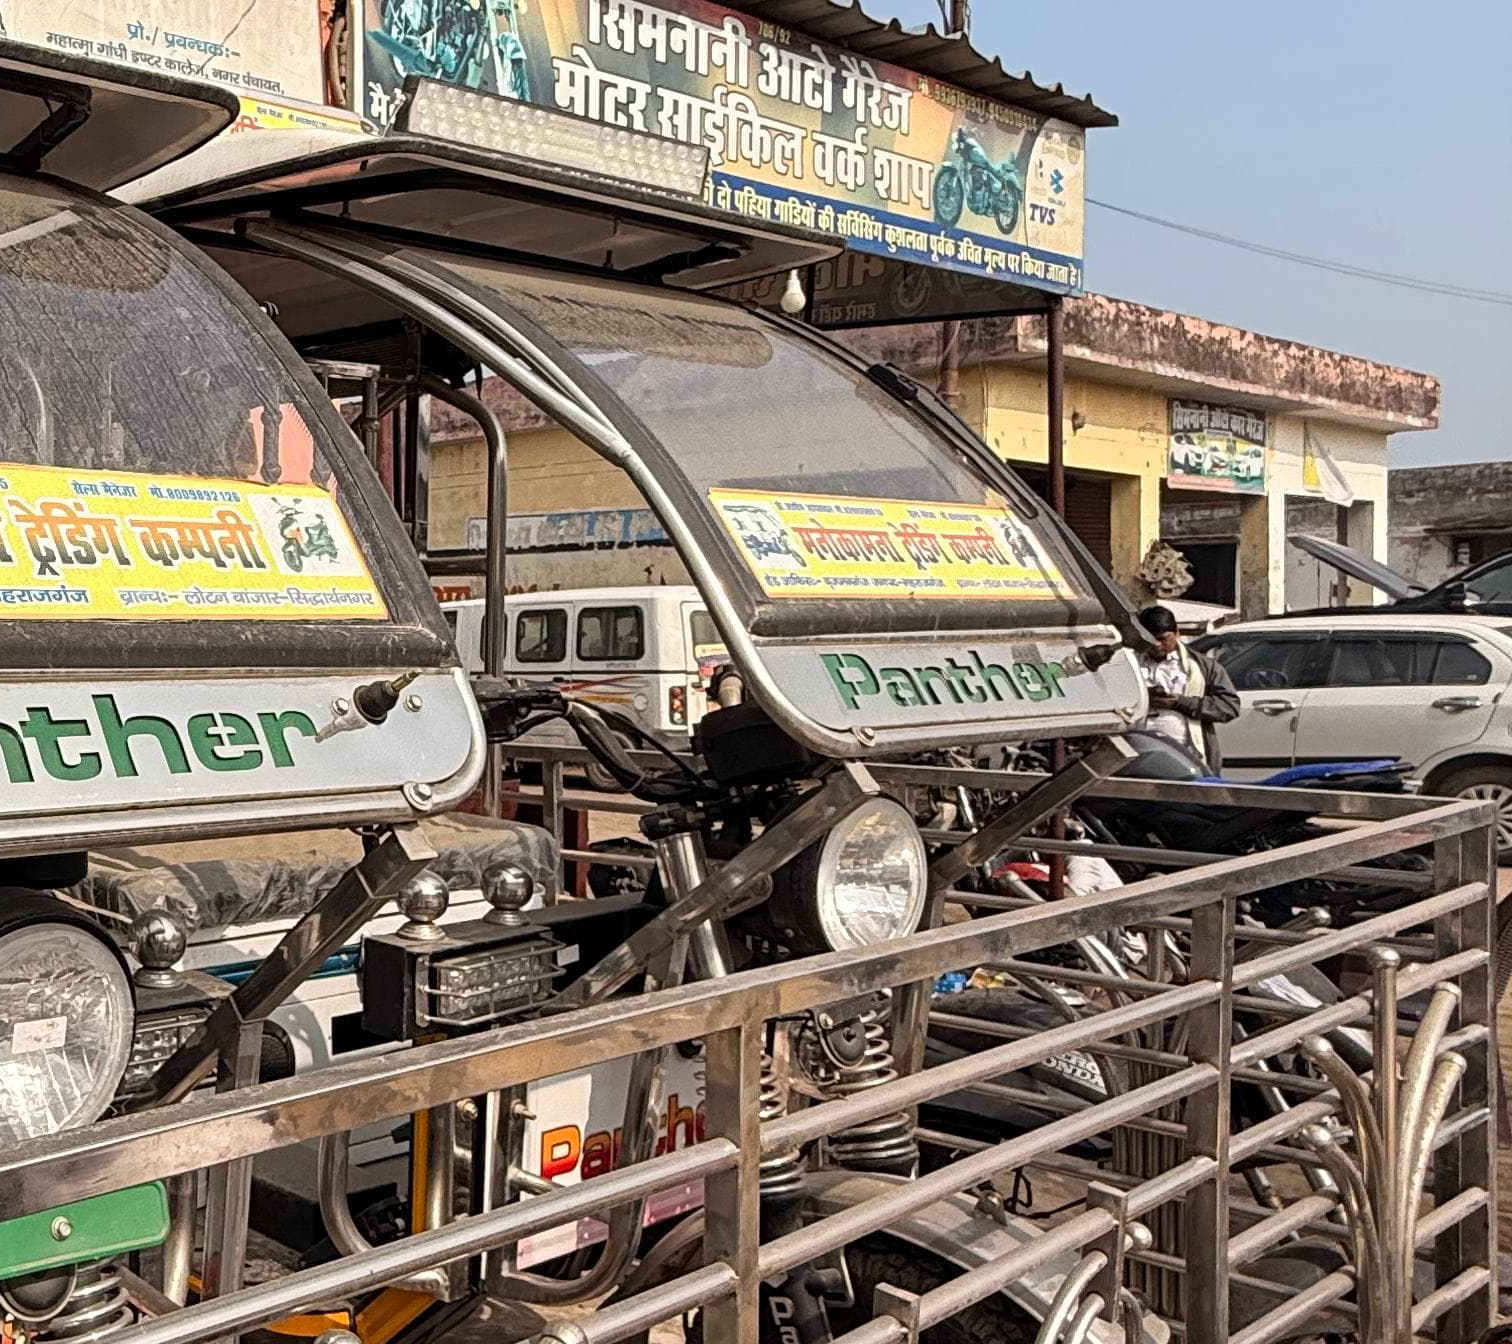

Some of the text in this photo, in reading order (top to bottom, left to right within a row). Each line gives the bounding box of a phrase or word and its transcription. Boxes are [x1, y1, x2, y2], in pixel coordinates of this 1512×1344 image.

[46, 32, 94, 55] महात्मा
[96, 42, 128, 61] गांधी
[130, 50, 162, 69] इण्टर
[212, 67, 241, 85] नगर
[757, 42, 836, 113] आटो
[839, 55, 913, 135] गैरेज
[552, 46, 934, 210] मोटर साईकिल वर्क शाप
[717, 179, 732, 209] दो
[734, 186, 773, 220] पहिया
[817, 204, 835, 233] की
[884, 223, 929, 254] कुशलता
[929, 229, 956, 263] पूर्वक
[957, 237, 983, 265] उचित
[1007, 252, 1021, 274] पर
[1021, 251, 1045, 279] किया
[1045, 264, 1070, 285] जाता
[1030, 203, 1056, 226] TVS
[8, 498, 131, 576] ट्रेडिंग
[130, 510, 267, 569] कम्पनी
[792, 519, 898, 563] मनोकामना
[943, 527, 1010, 566] कम्पनी
[819, 649, 1069, 711] Panther
